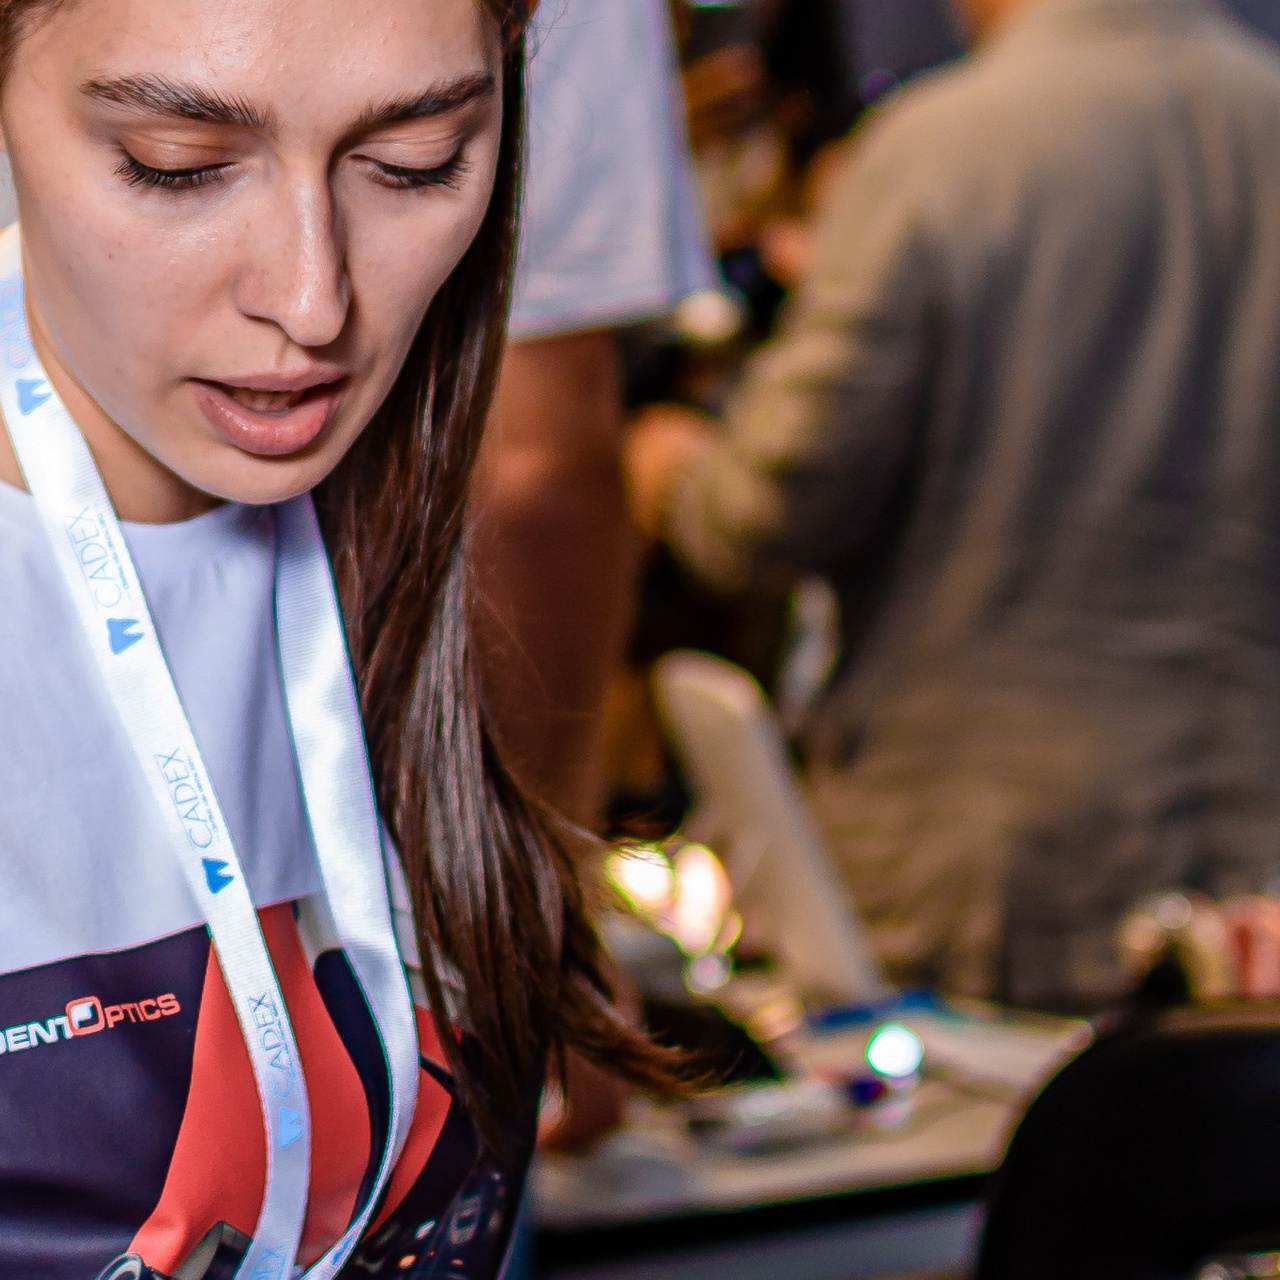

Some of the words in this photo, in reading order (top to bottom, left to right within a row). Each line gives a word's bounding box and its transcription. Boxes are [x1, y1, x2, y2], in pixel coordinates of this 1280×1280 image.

[62, 504, 123, 609] CADEX
[155, 746, 213, 850] CADEX
[248, 990, 296, 1101] CADEX
